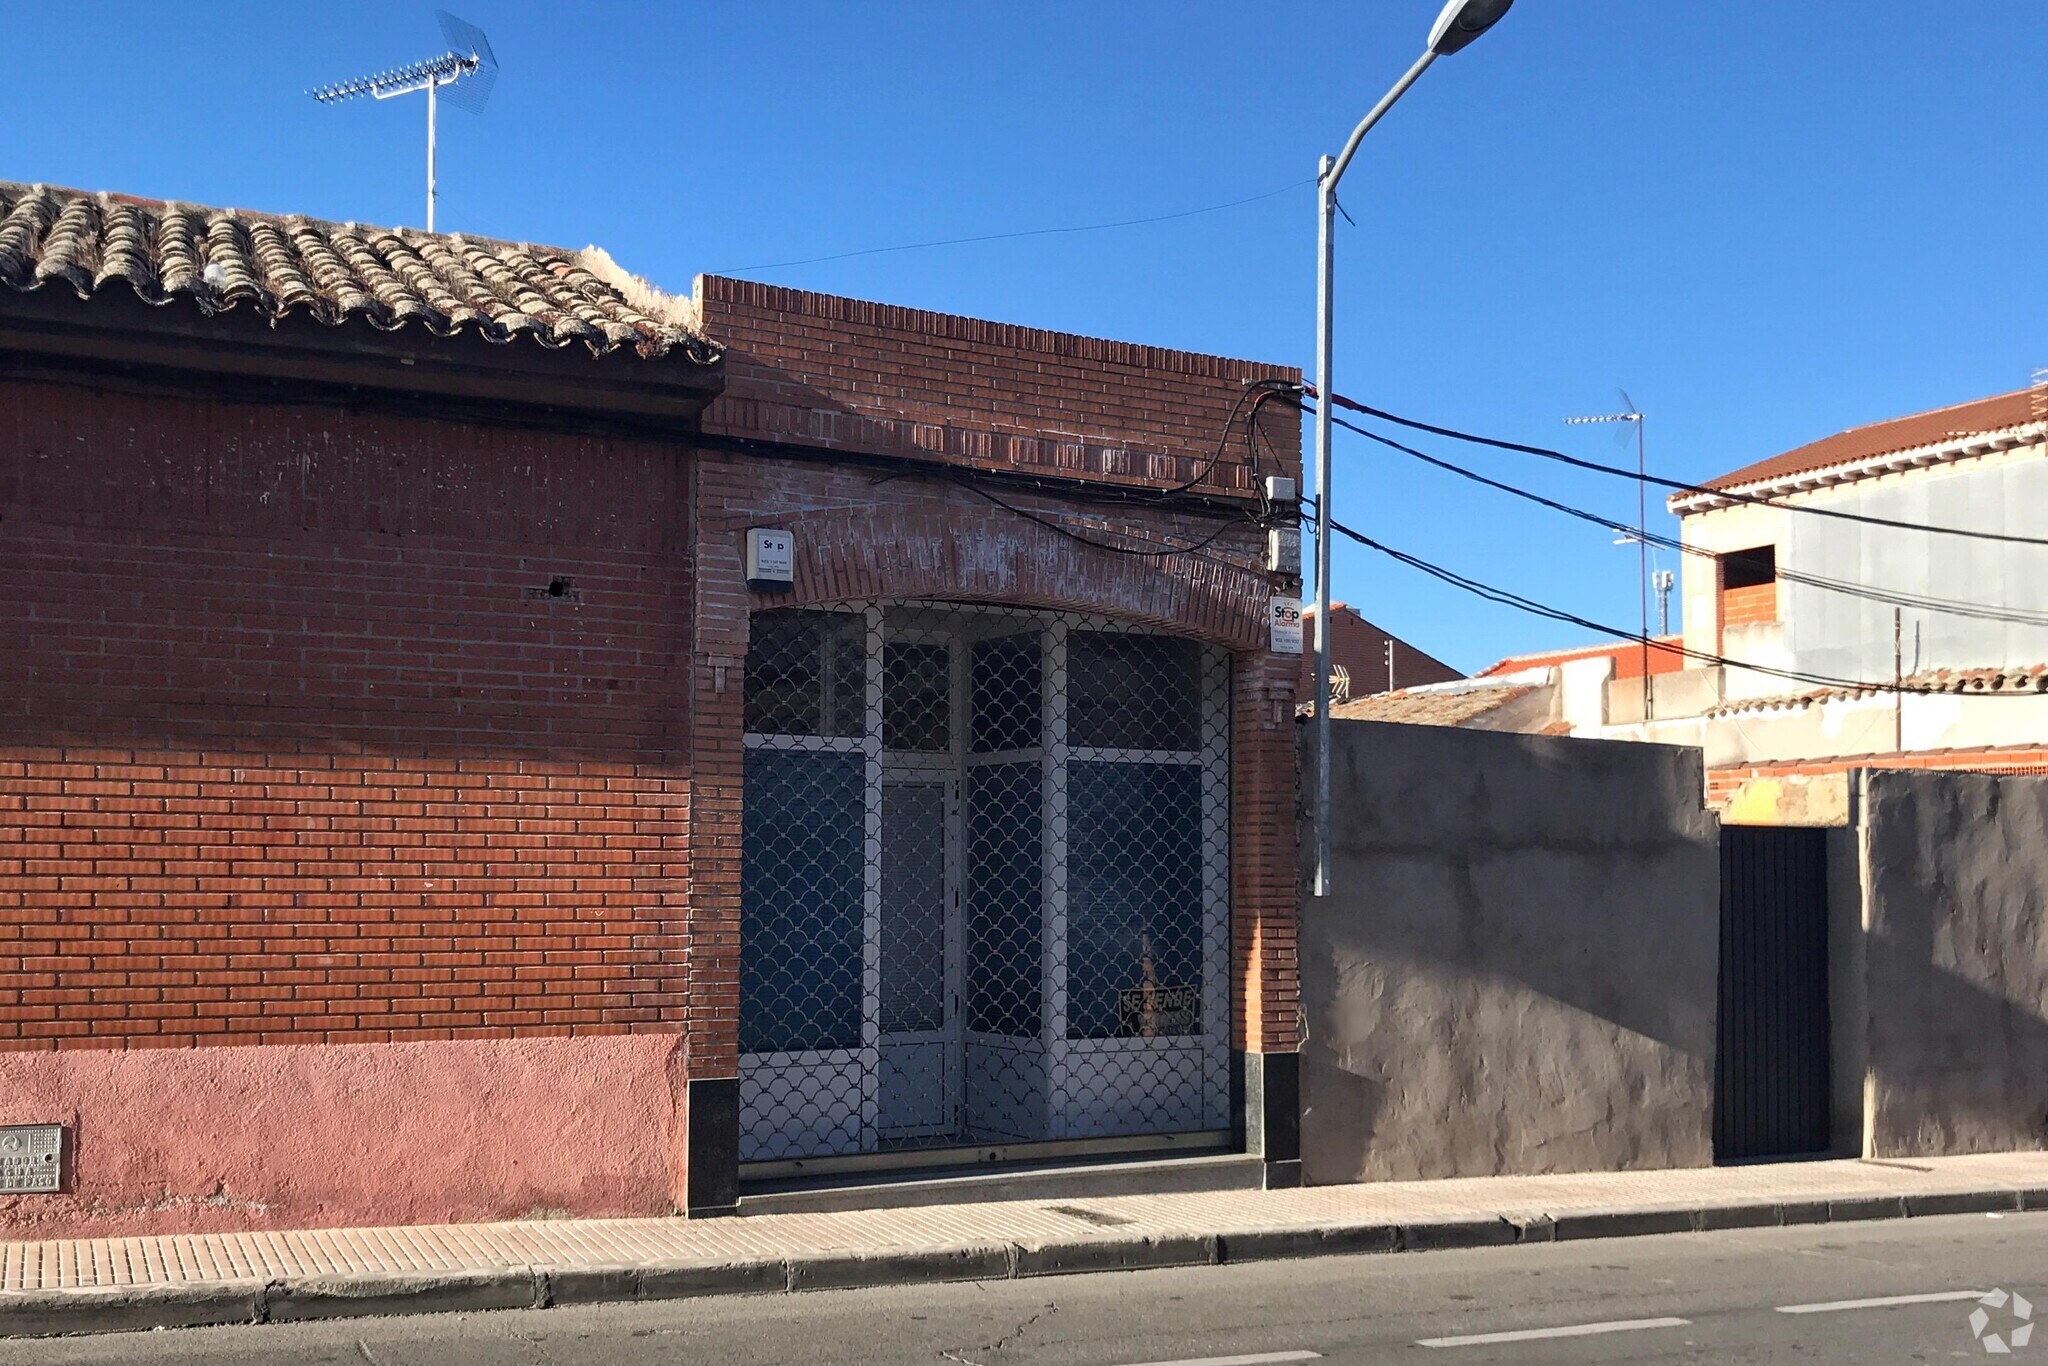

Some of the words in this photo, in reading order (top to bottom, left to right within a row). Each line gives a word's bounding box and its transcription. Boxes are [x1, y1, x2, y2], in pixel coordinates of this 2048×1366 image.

[764, 540, 784, 552] Stp
[1275, 606, 1299, 621] Stop
[1274, 618, 1300, 628] Alarma
[1122, 994, 1141, 1012] SE
[24, 1176, 52, 1187] PASO
